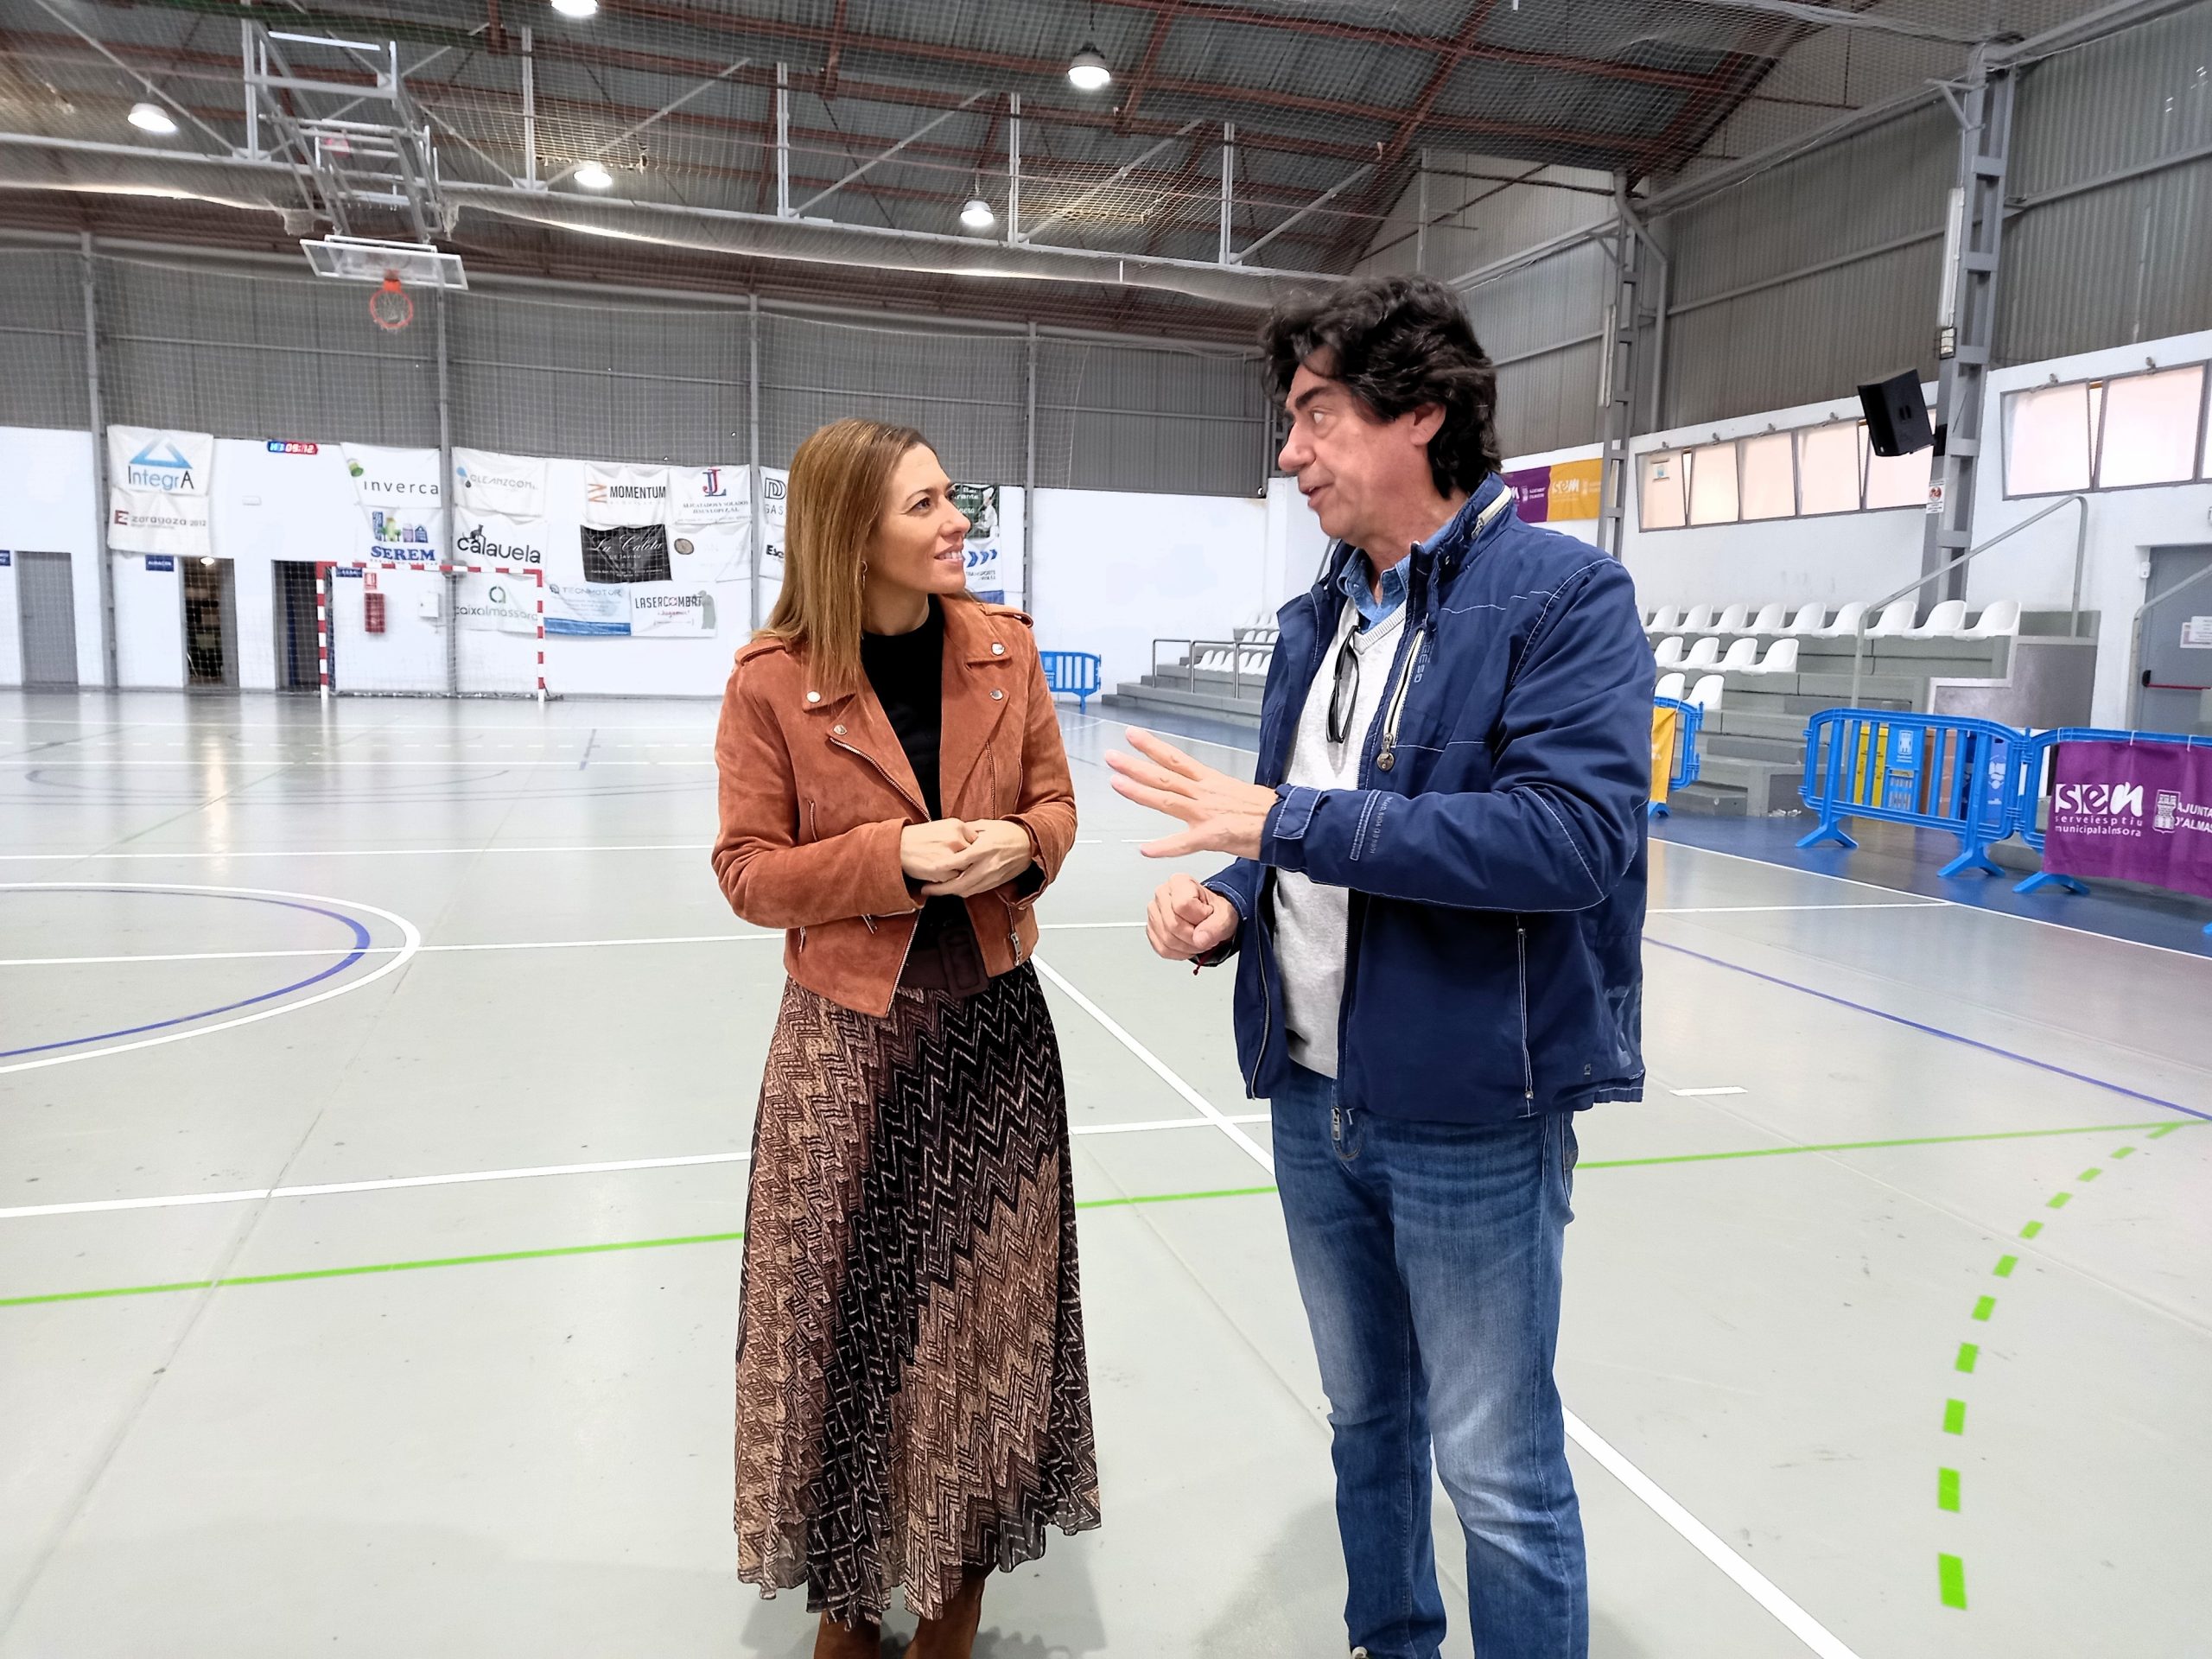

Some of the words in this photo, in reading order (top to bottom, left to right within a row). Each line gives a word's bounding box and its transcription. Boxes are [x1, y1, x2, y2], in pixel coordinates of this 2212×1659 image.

[128, 465, 194, 491] IntegrA
[364, 480, 439, 495] inverca
[610, 486, 666, 499] MOMENTUM
[131, 516, 187, 526] zaragoza
[371, 545, 435, 561] SEREM
